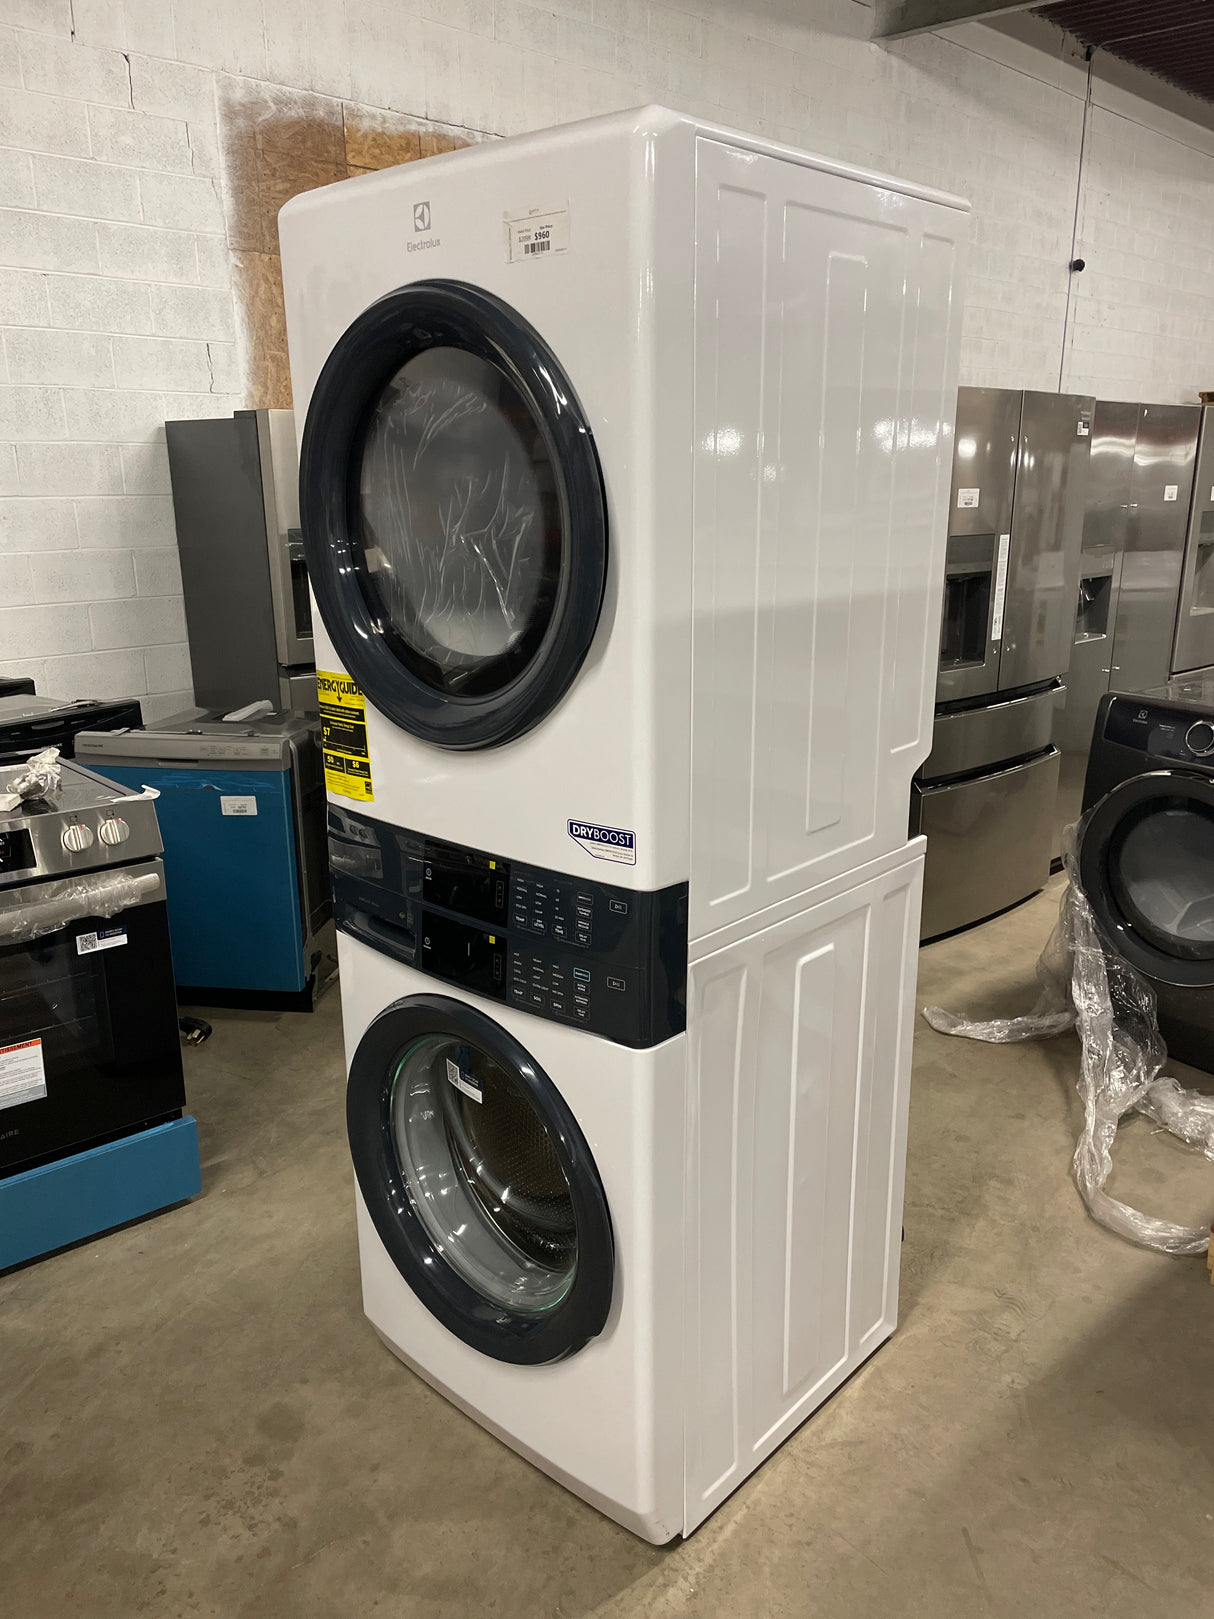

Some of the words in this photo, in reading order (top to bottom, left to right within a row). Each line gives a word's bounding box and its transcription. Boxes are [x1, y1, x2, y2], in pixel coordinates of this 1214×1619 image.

[534, 230, 550, 241] $960
[406, 238, 440, 252] Electrolux
[323, 726, 330, 736] $7
[572, 824, 632, 846] DRYBOOST
